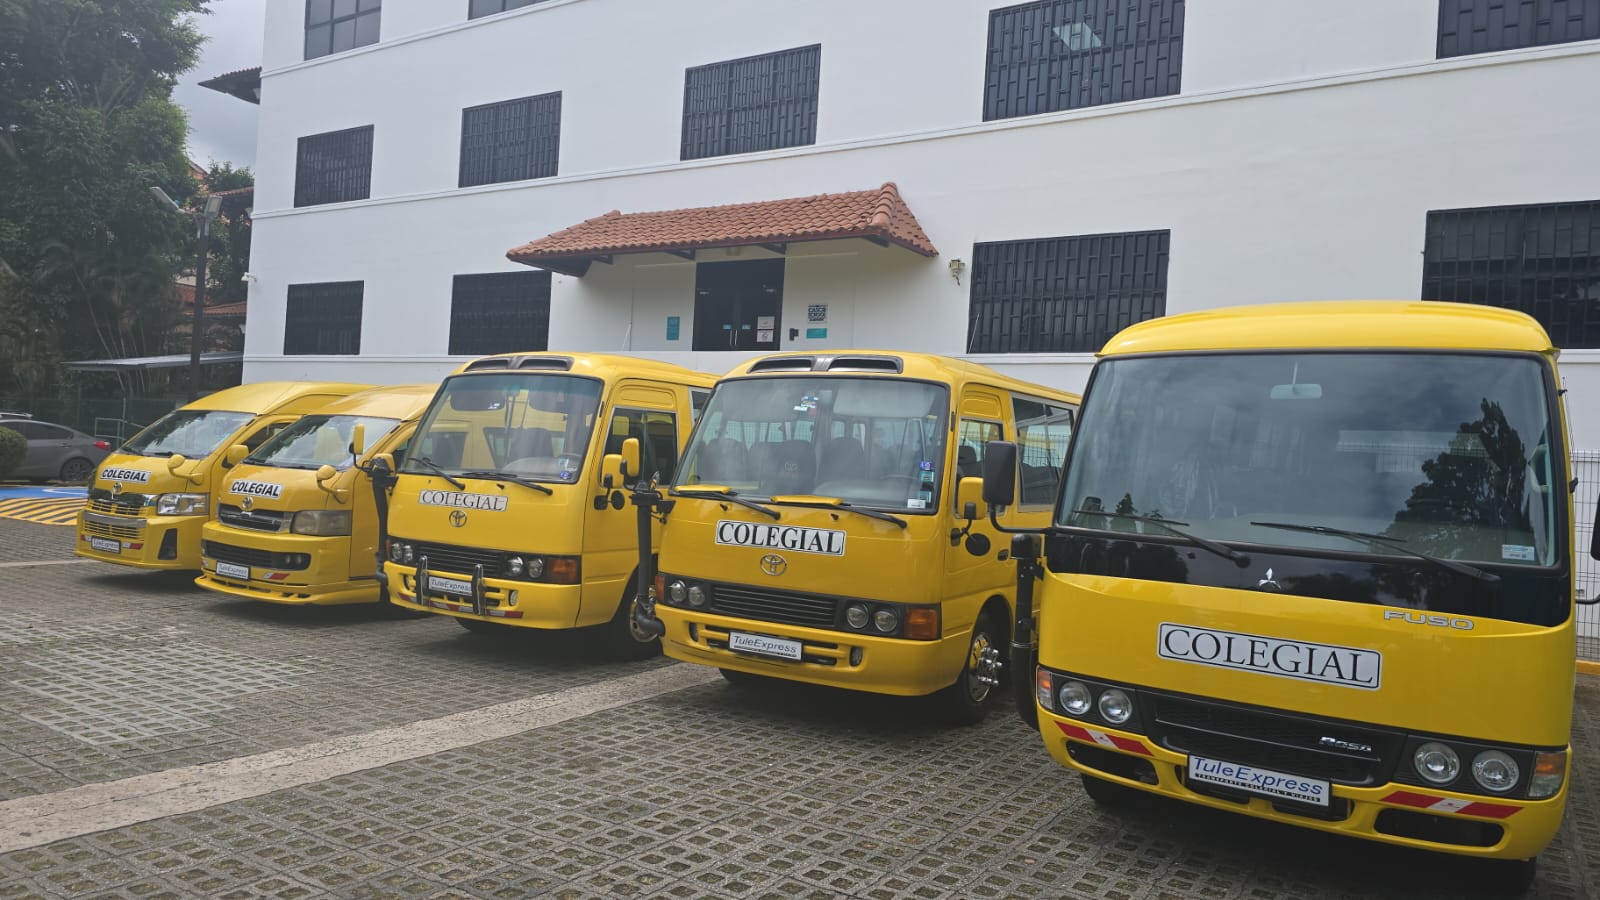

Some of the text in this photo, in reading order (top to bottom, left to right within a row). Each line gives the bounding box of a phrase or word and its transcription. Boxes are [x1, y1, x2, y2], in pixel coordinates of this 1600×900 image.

[102, 468, 148, 482] COLEGIAL
[231, 480, 280, 498] COLEGIAL
[422, 491, 504, 510] COLEGIAL
[719, 522, 842, 553] COLEGIAL
[1383, 609, 1475, 631] FUSO
[734, 635, 797, 653] TuleExpress
[1164, 627, 1375, 685] COLEGIAL
[1194, 757, 1323, 795] TuleExpress
